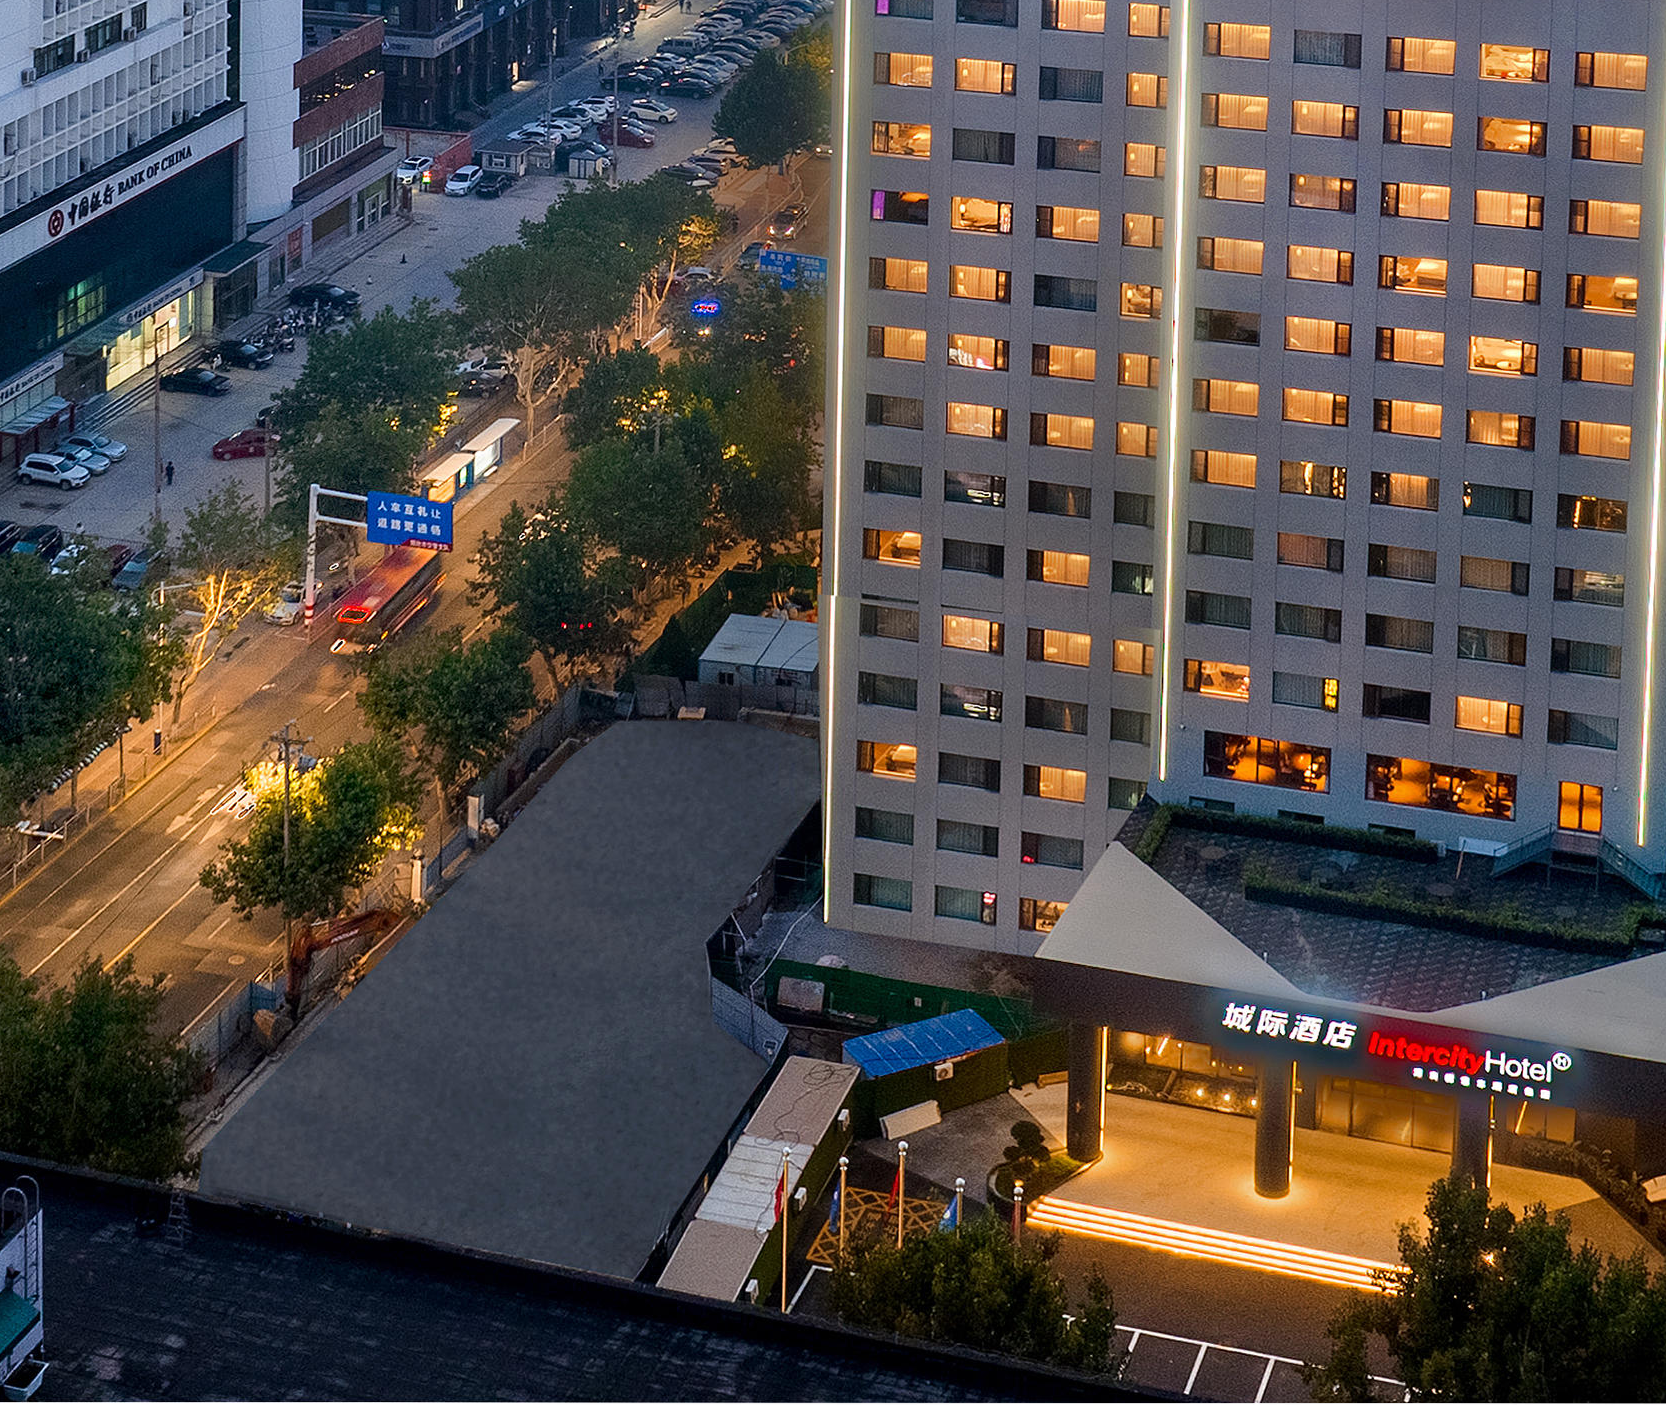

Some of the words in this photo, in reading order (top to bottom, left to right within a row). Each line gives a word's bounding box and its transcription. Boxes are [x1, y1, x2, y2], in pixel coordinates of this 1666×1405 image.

[67, 183, 115, 226] 中国银行
[117, 169, 146, 196] BANK
[146, 161, 161, 179] OF
[161, 145, 193, 172] CHINA
[377, 500, 442, 520] 人车互礼让
[377, 517, 442, 537] 道路更通畅
[1221, 1001, 1359, 1051] 城际酒店
